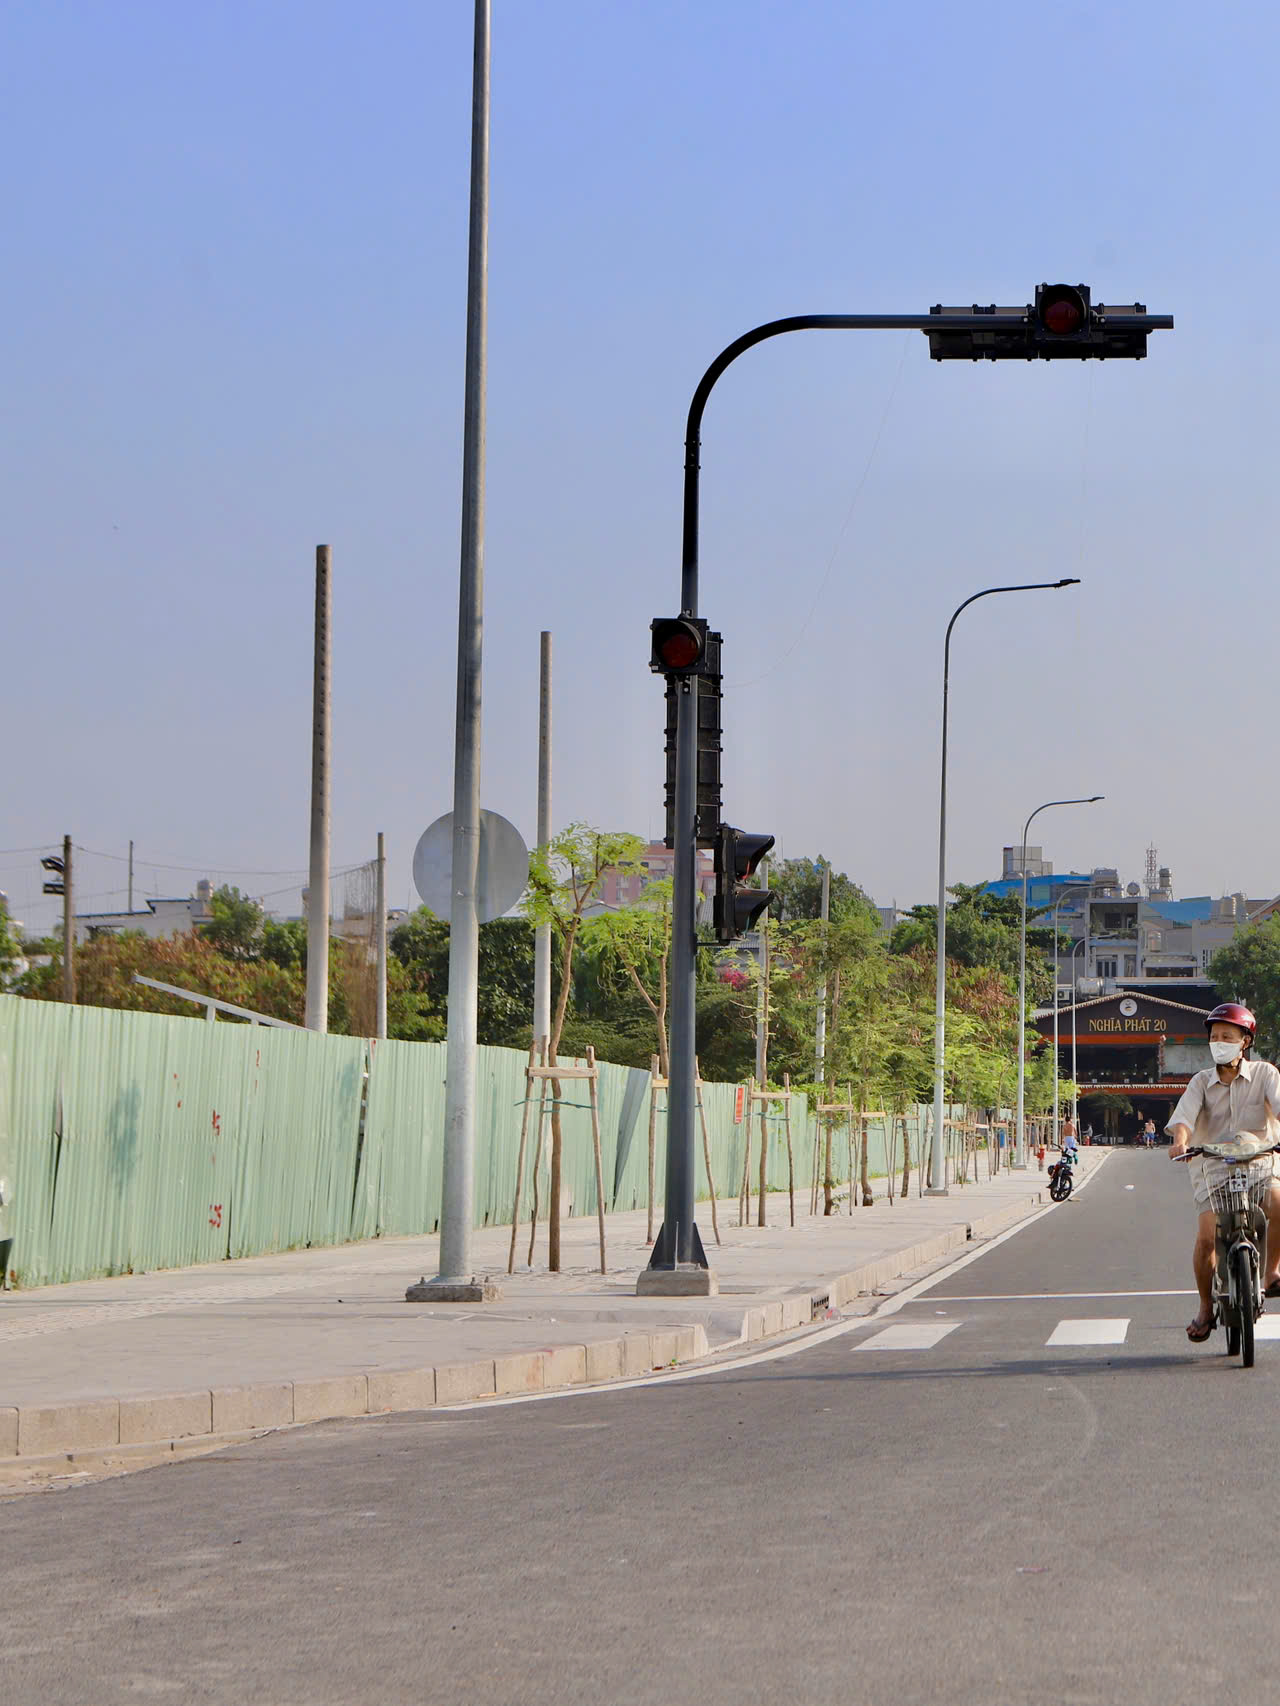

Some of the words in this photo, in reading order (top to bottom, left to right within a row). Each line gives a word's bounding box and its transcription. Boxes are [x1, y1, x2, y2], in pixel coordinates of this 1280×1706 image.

[1089, 1017, 1121, 1031] NGHĨA
[1125, 1017, 1151, 1031] PHÁT
[1154, 1019, 1167, 1031] 20
